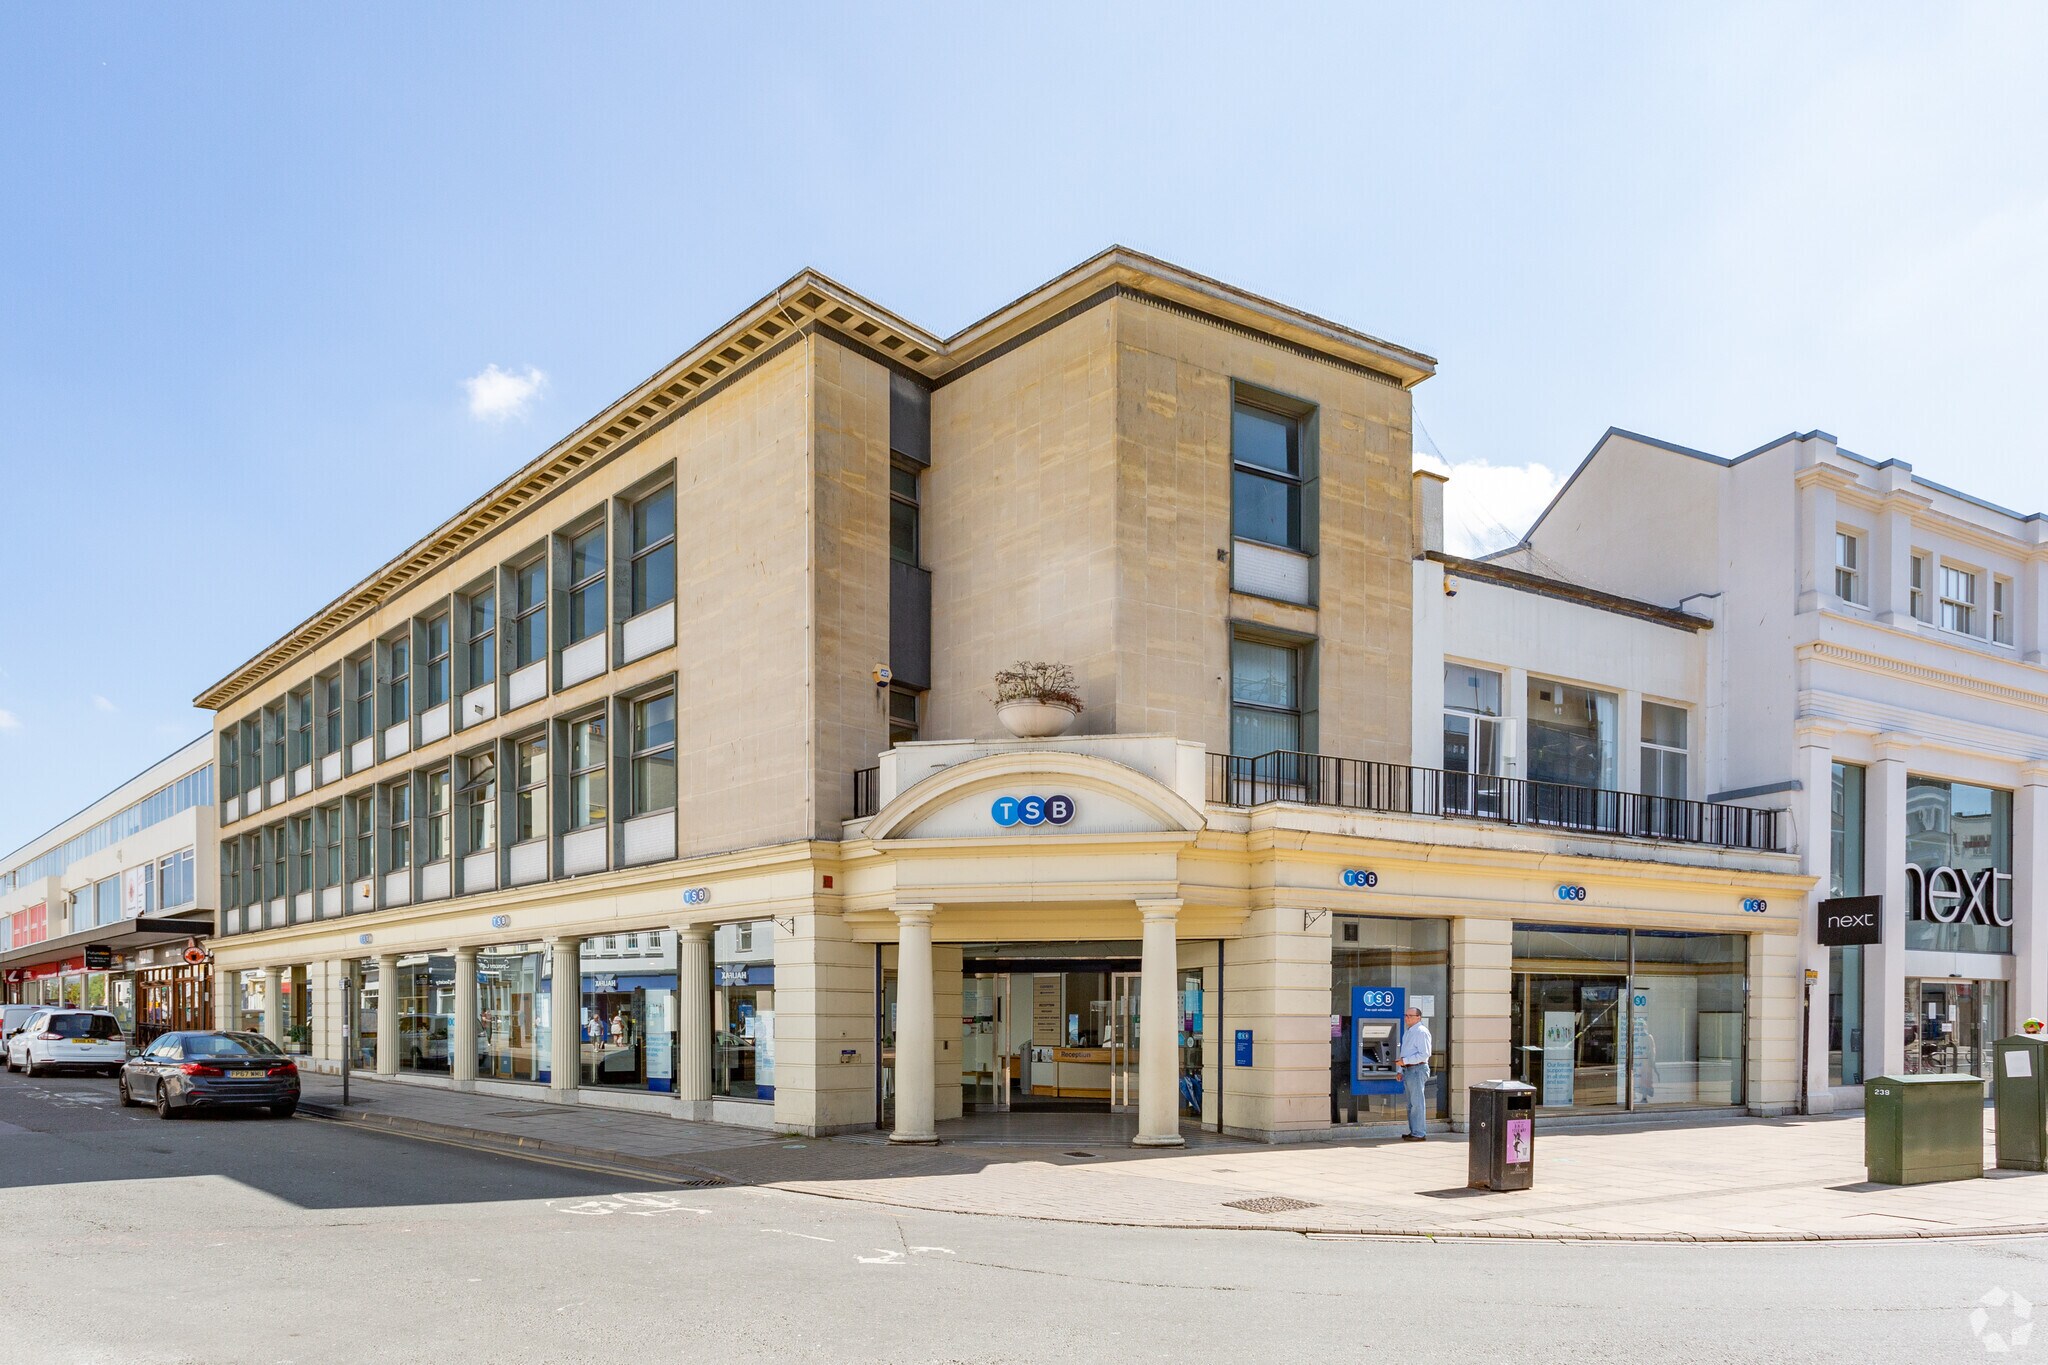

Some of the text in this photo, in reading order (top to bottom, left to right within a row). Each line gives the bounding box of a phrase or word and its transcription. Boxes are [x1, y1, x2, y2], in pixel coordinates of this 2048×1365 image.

[998, 799, 1069, 821] TSB
[1346, 872, 1376, 885] TSB
[684, 889, 705, 902] TSB
[1560, 887, 1585, 899] TSB
[1905, 863, 2013, 927] next
[1745, 900, 1766, 911] TSB
[1828, 914, 1874, 928] next
[1366, 993, 1392, 1005] TSB
